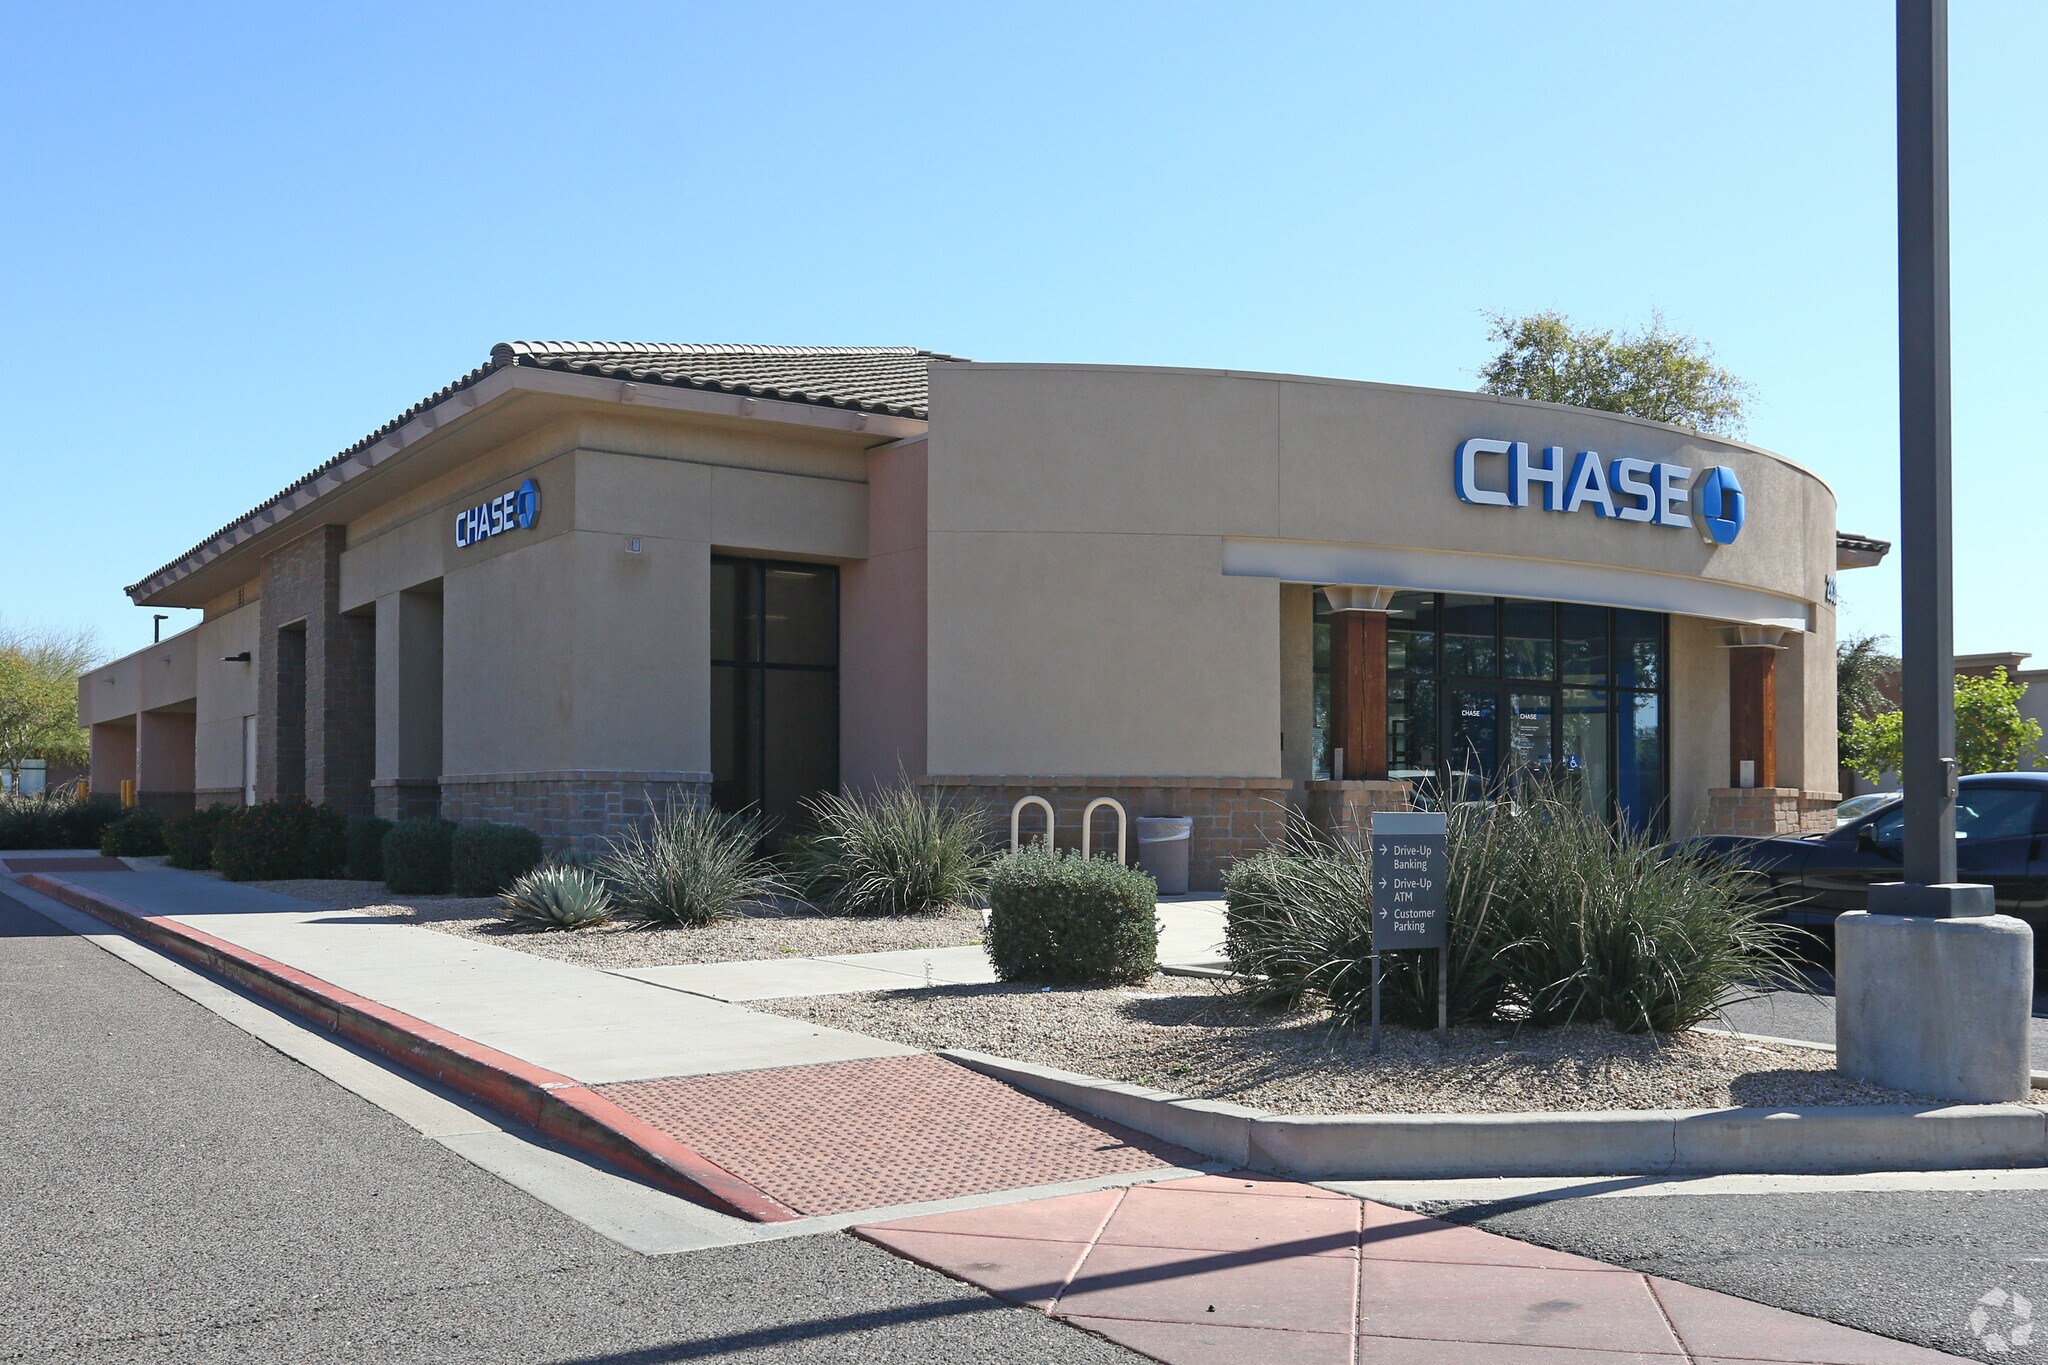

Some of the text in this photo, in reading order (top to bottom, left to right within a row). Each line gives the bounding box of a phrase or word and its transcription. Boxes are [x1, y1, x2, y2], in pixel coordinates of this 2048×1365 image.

[1454, 438, 1693, 528] CHASE
[455, 490, 516, 548] CHASE
[1461, 709, 1480, 717] CHASE
[1394, 845, 1432, 858] Drive-Up
[1394, 859, 1428, 872] Banking
[1394, 878, 1432, 891] Drive-Up
[1394, 892, 1413, 902] ATM
[1394, 908, 1435, 919] Customer
[1394, 920, 1425, 933] Parking
